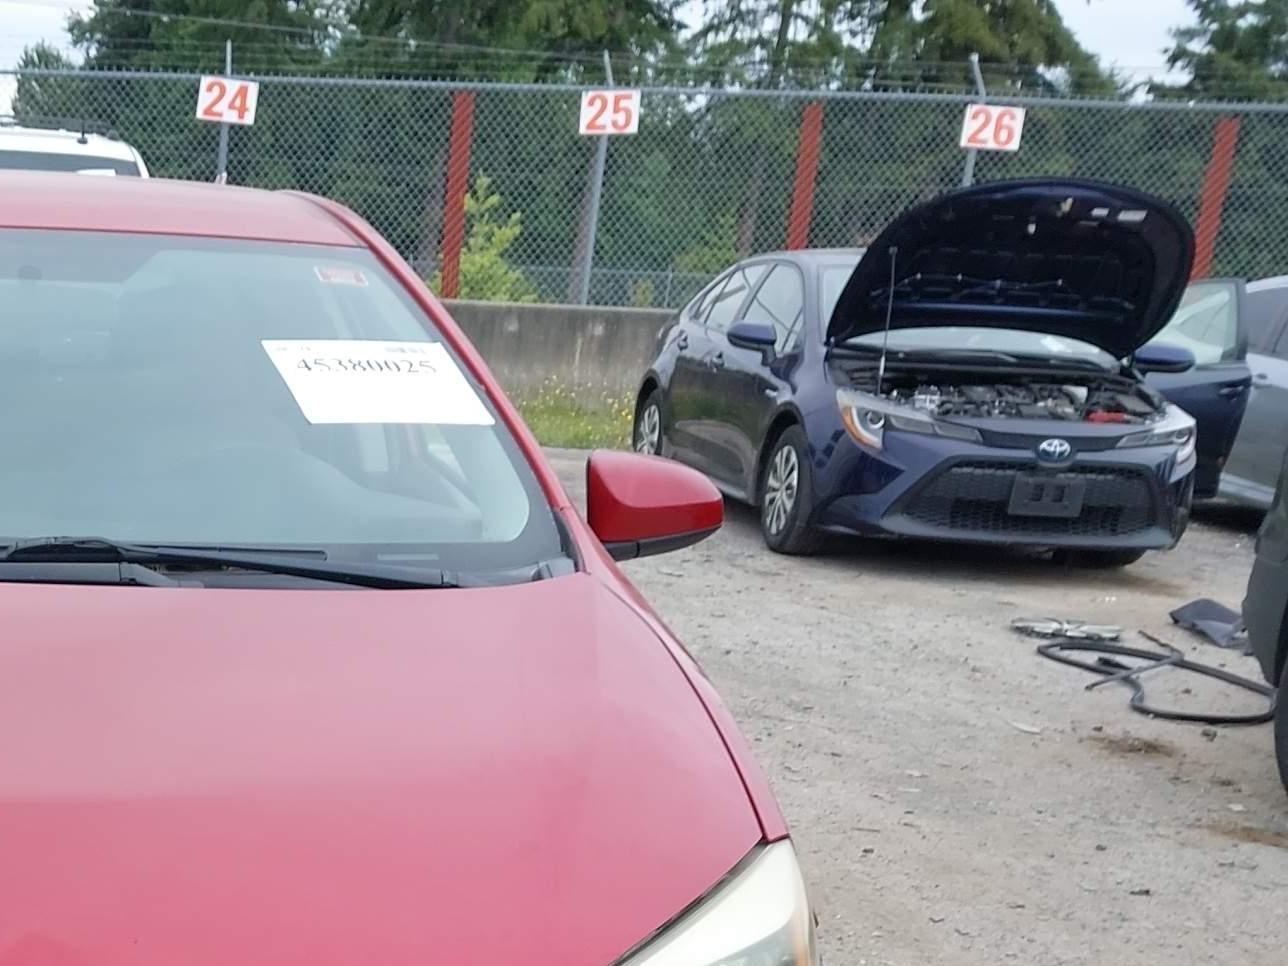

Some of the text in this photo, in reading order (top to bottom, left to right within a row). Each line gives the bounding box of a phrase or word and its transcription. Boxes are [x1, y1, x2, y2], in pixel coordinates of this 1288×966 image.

[203, 80, 251, 121] 24
[585, 92, 633, 133] 25
[966, 107, 1016, 149] 26
